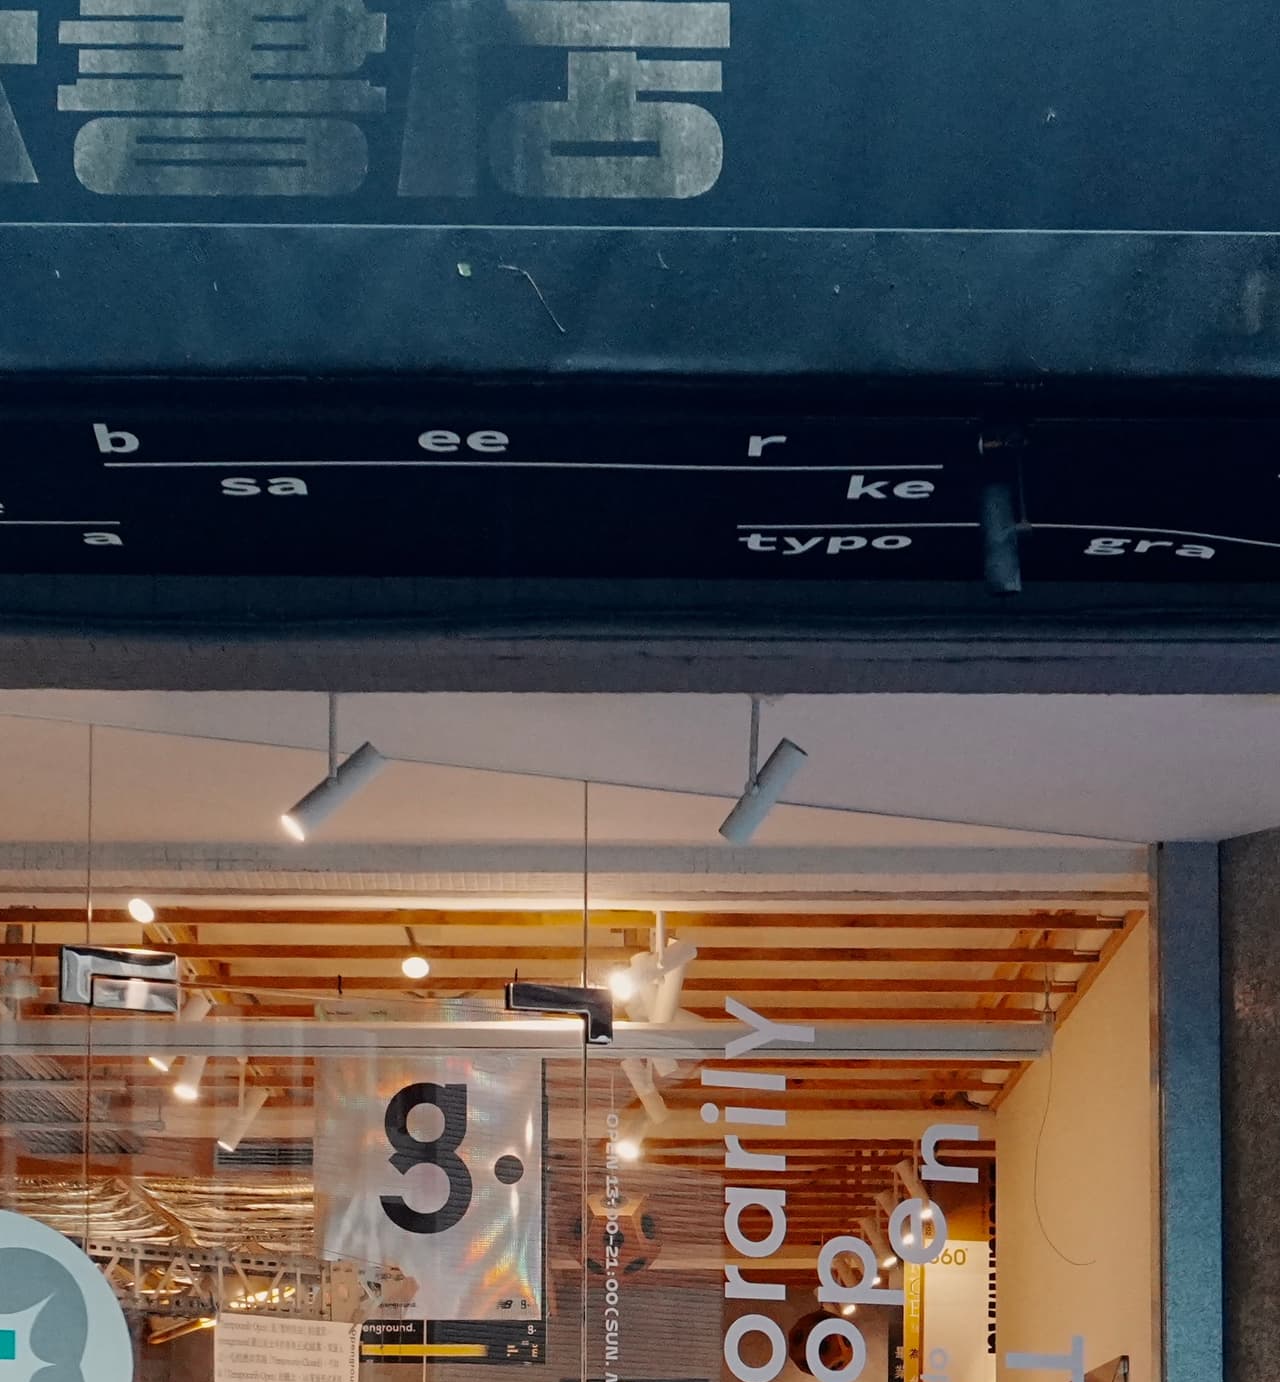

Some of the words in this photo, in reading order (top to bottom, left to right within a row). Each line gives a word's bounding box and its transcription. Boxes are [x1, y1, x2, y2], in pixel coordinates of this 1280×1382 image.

[92, 423, 140, 453] b
[417, 430, 509, 452] ee
[747, 434, 787, 457] r
[220, 476, 308, 496] sa
[846, 474, 934, 500] ke
[83, 531, 123, 546] a
[738, 532, 912, 555] typo
[1084, 536, 1216, 559] gra
